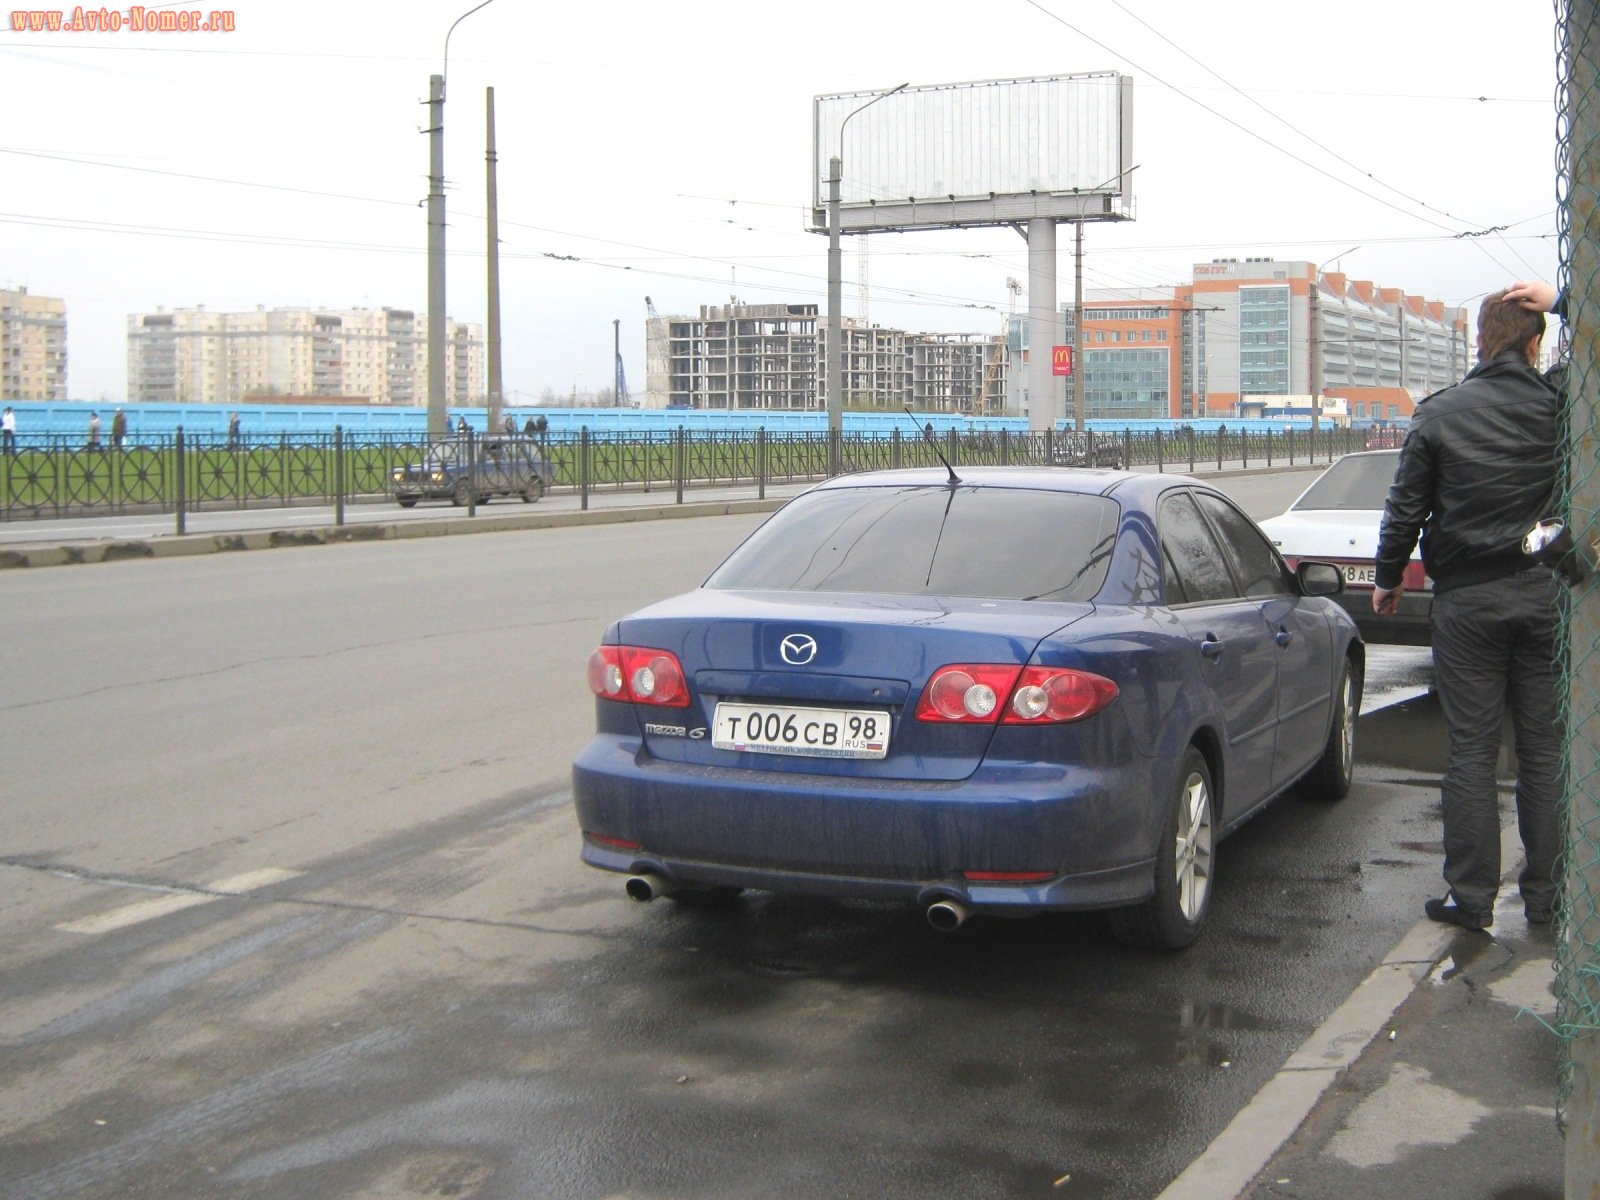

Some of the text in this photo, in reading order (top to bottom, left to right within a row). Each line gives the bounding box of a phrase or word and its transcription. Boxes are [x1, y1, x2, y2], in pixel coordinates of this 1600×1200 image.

[689, 727, 707, 739] 6
[849, 716, 877, 740] 98
[845, 739, 866, 749] RUS
